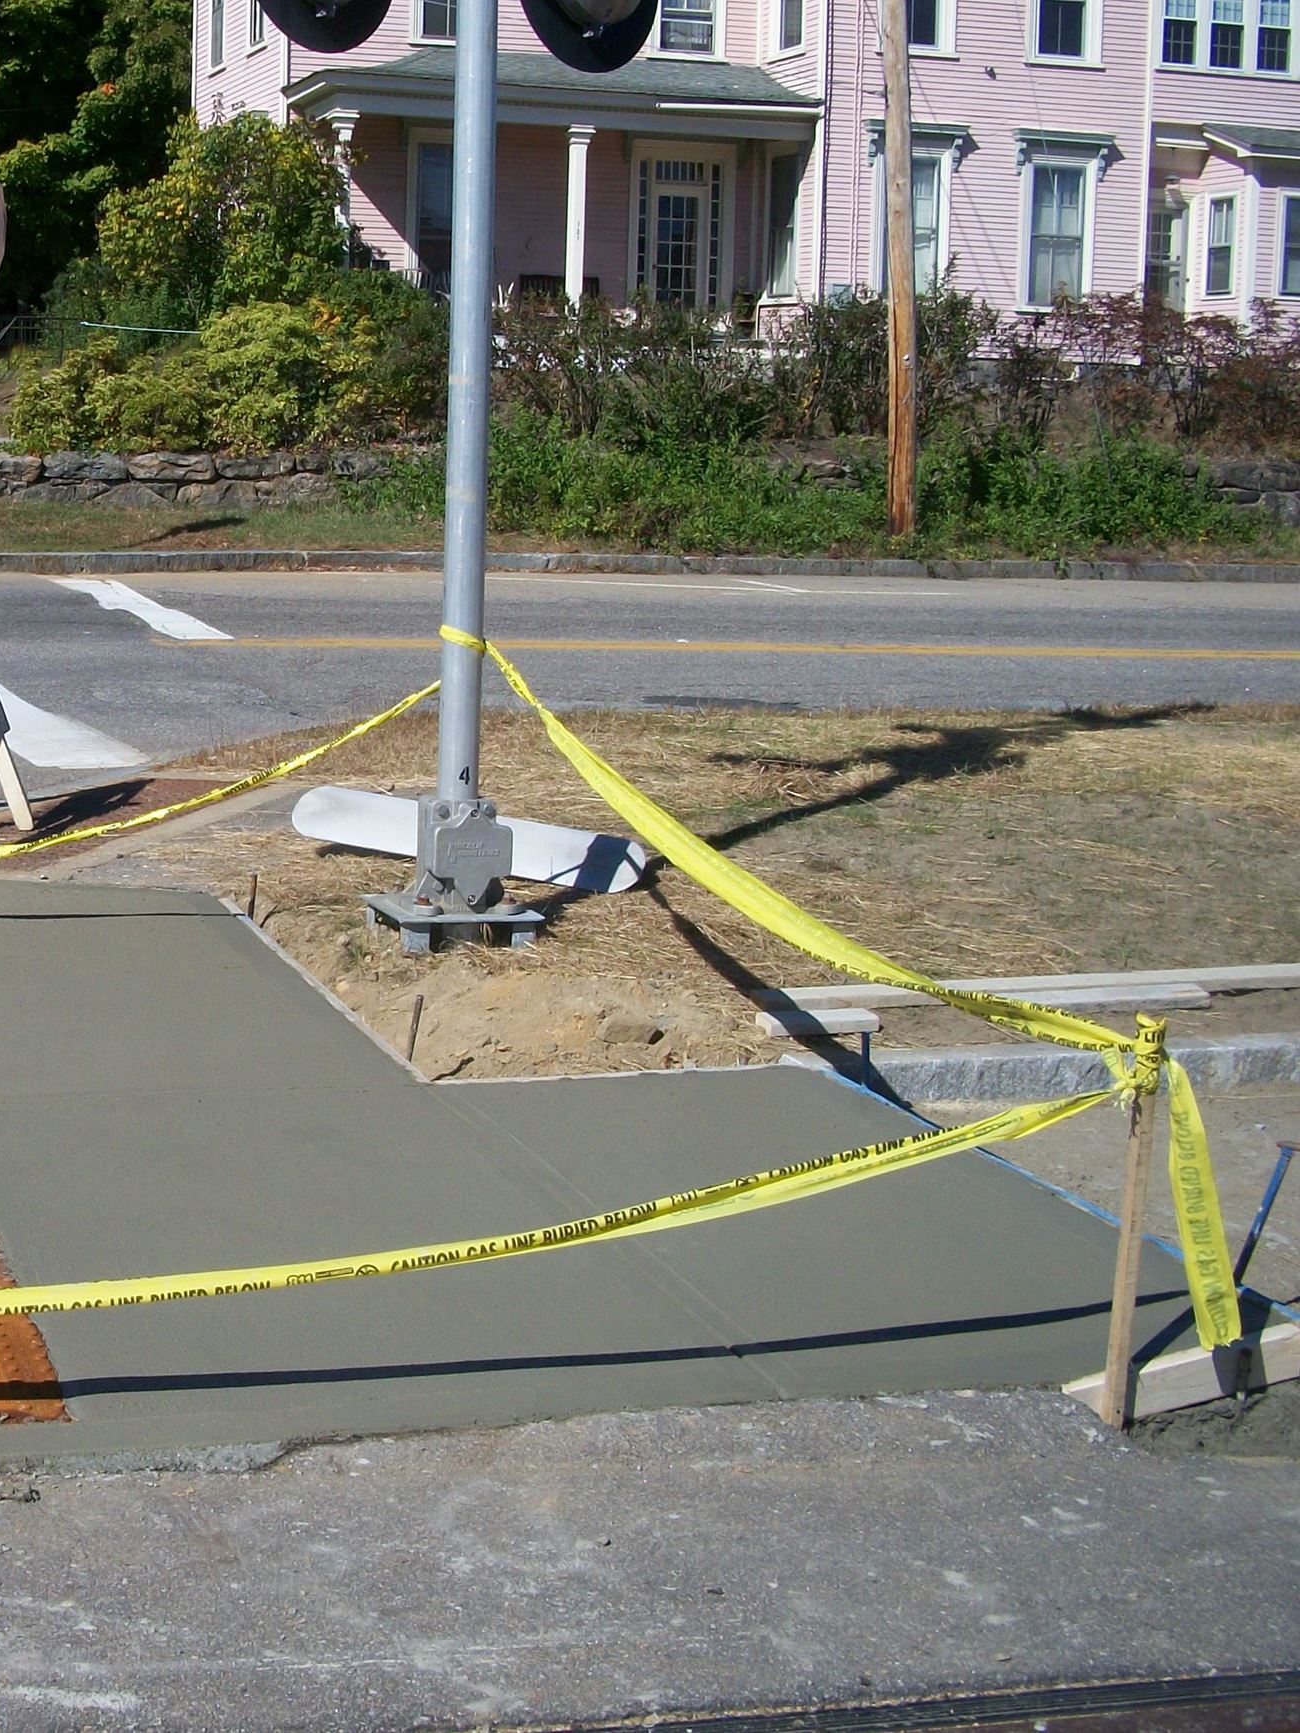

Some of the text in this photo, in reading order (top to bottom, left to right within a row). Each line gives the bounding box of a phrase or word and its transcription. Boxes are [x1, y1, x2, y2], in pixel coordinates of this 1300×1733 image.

[459, 766, 470, 785] 4
[839, 1145, 869, 1164] GAS
[875, 1136, 906, 1155] LINE
